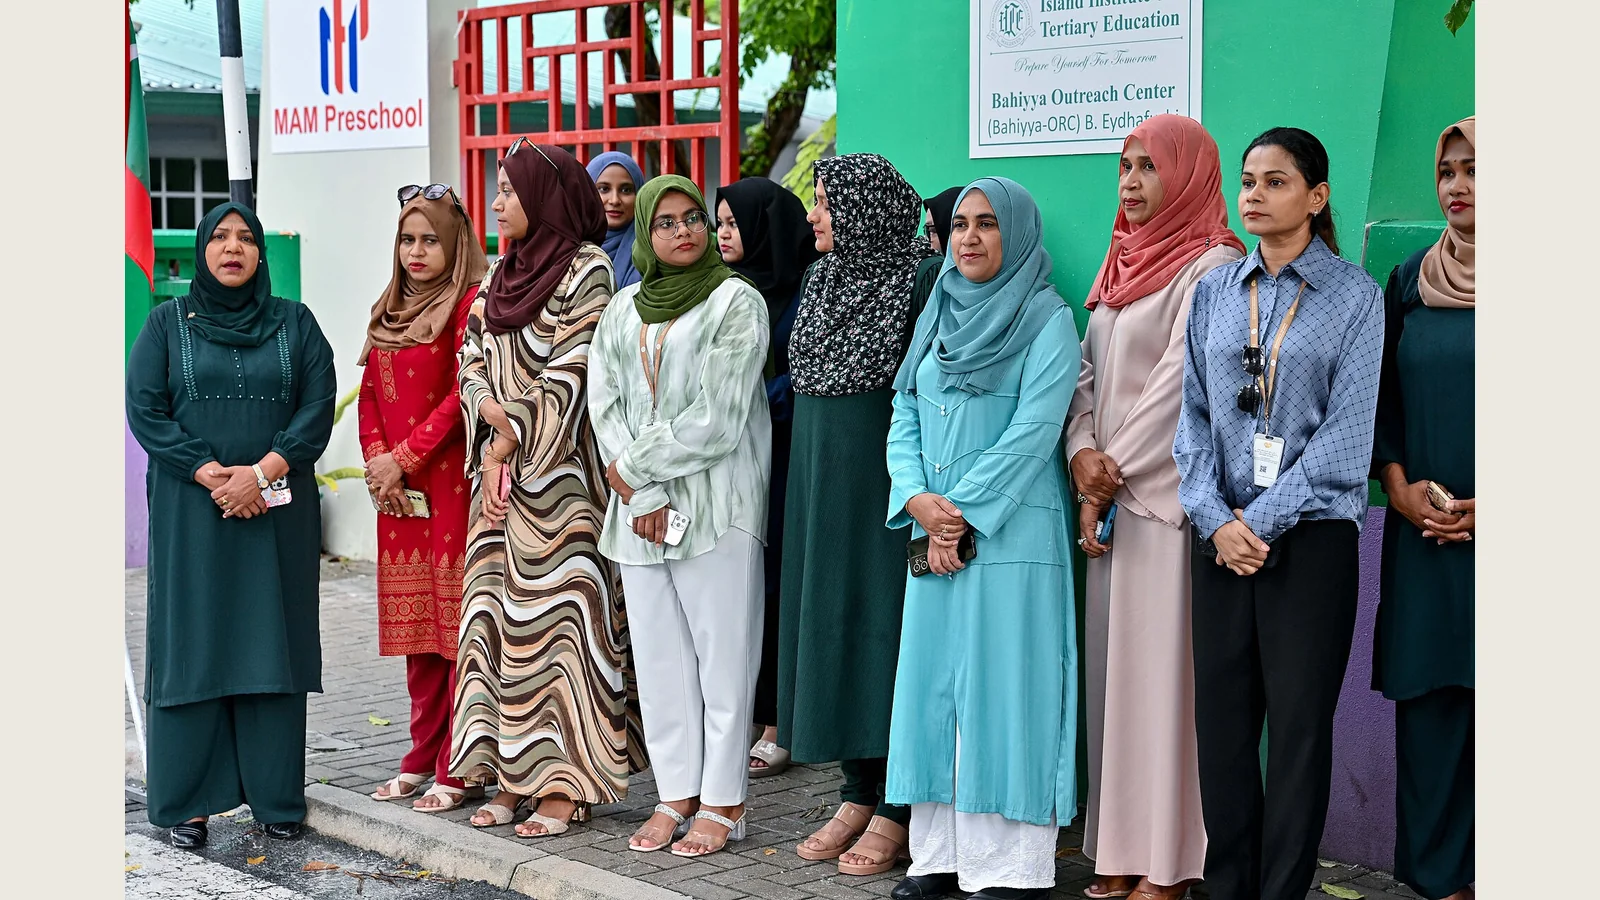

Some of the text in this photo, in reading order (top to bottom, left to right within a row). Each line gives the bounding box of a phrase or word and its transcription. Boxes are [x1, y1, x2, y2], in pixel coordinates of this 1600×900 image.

[1039, 10, 1180, 39] Tertiary Education
[1014, 49, 1158, 76] Prepare Yourself For Tomorrow
[991, 83, 1176, 112] Bahiyya Outreach Center
[274, 98, 423, 135] MAM Preschool
[987, 108, 1179, 138] (Bahiyya-ORC) B. Eydhaf
